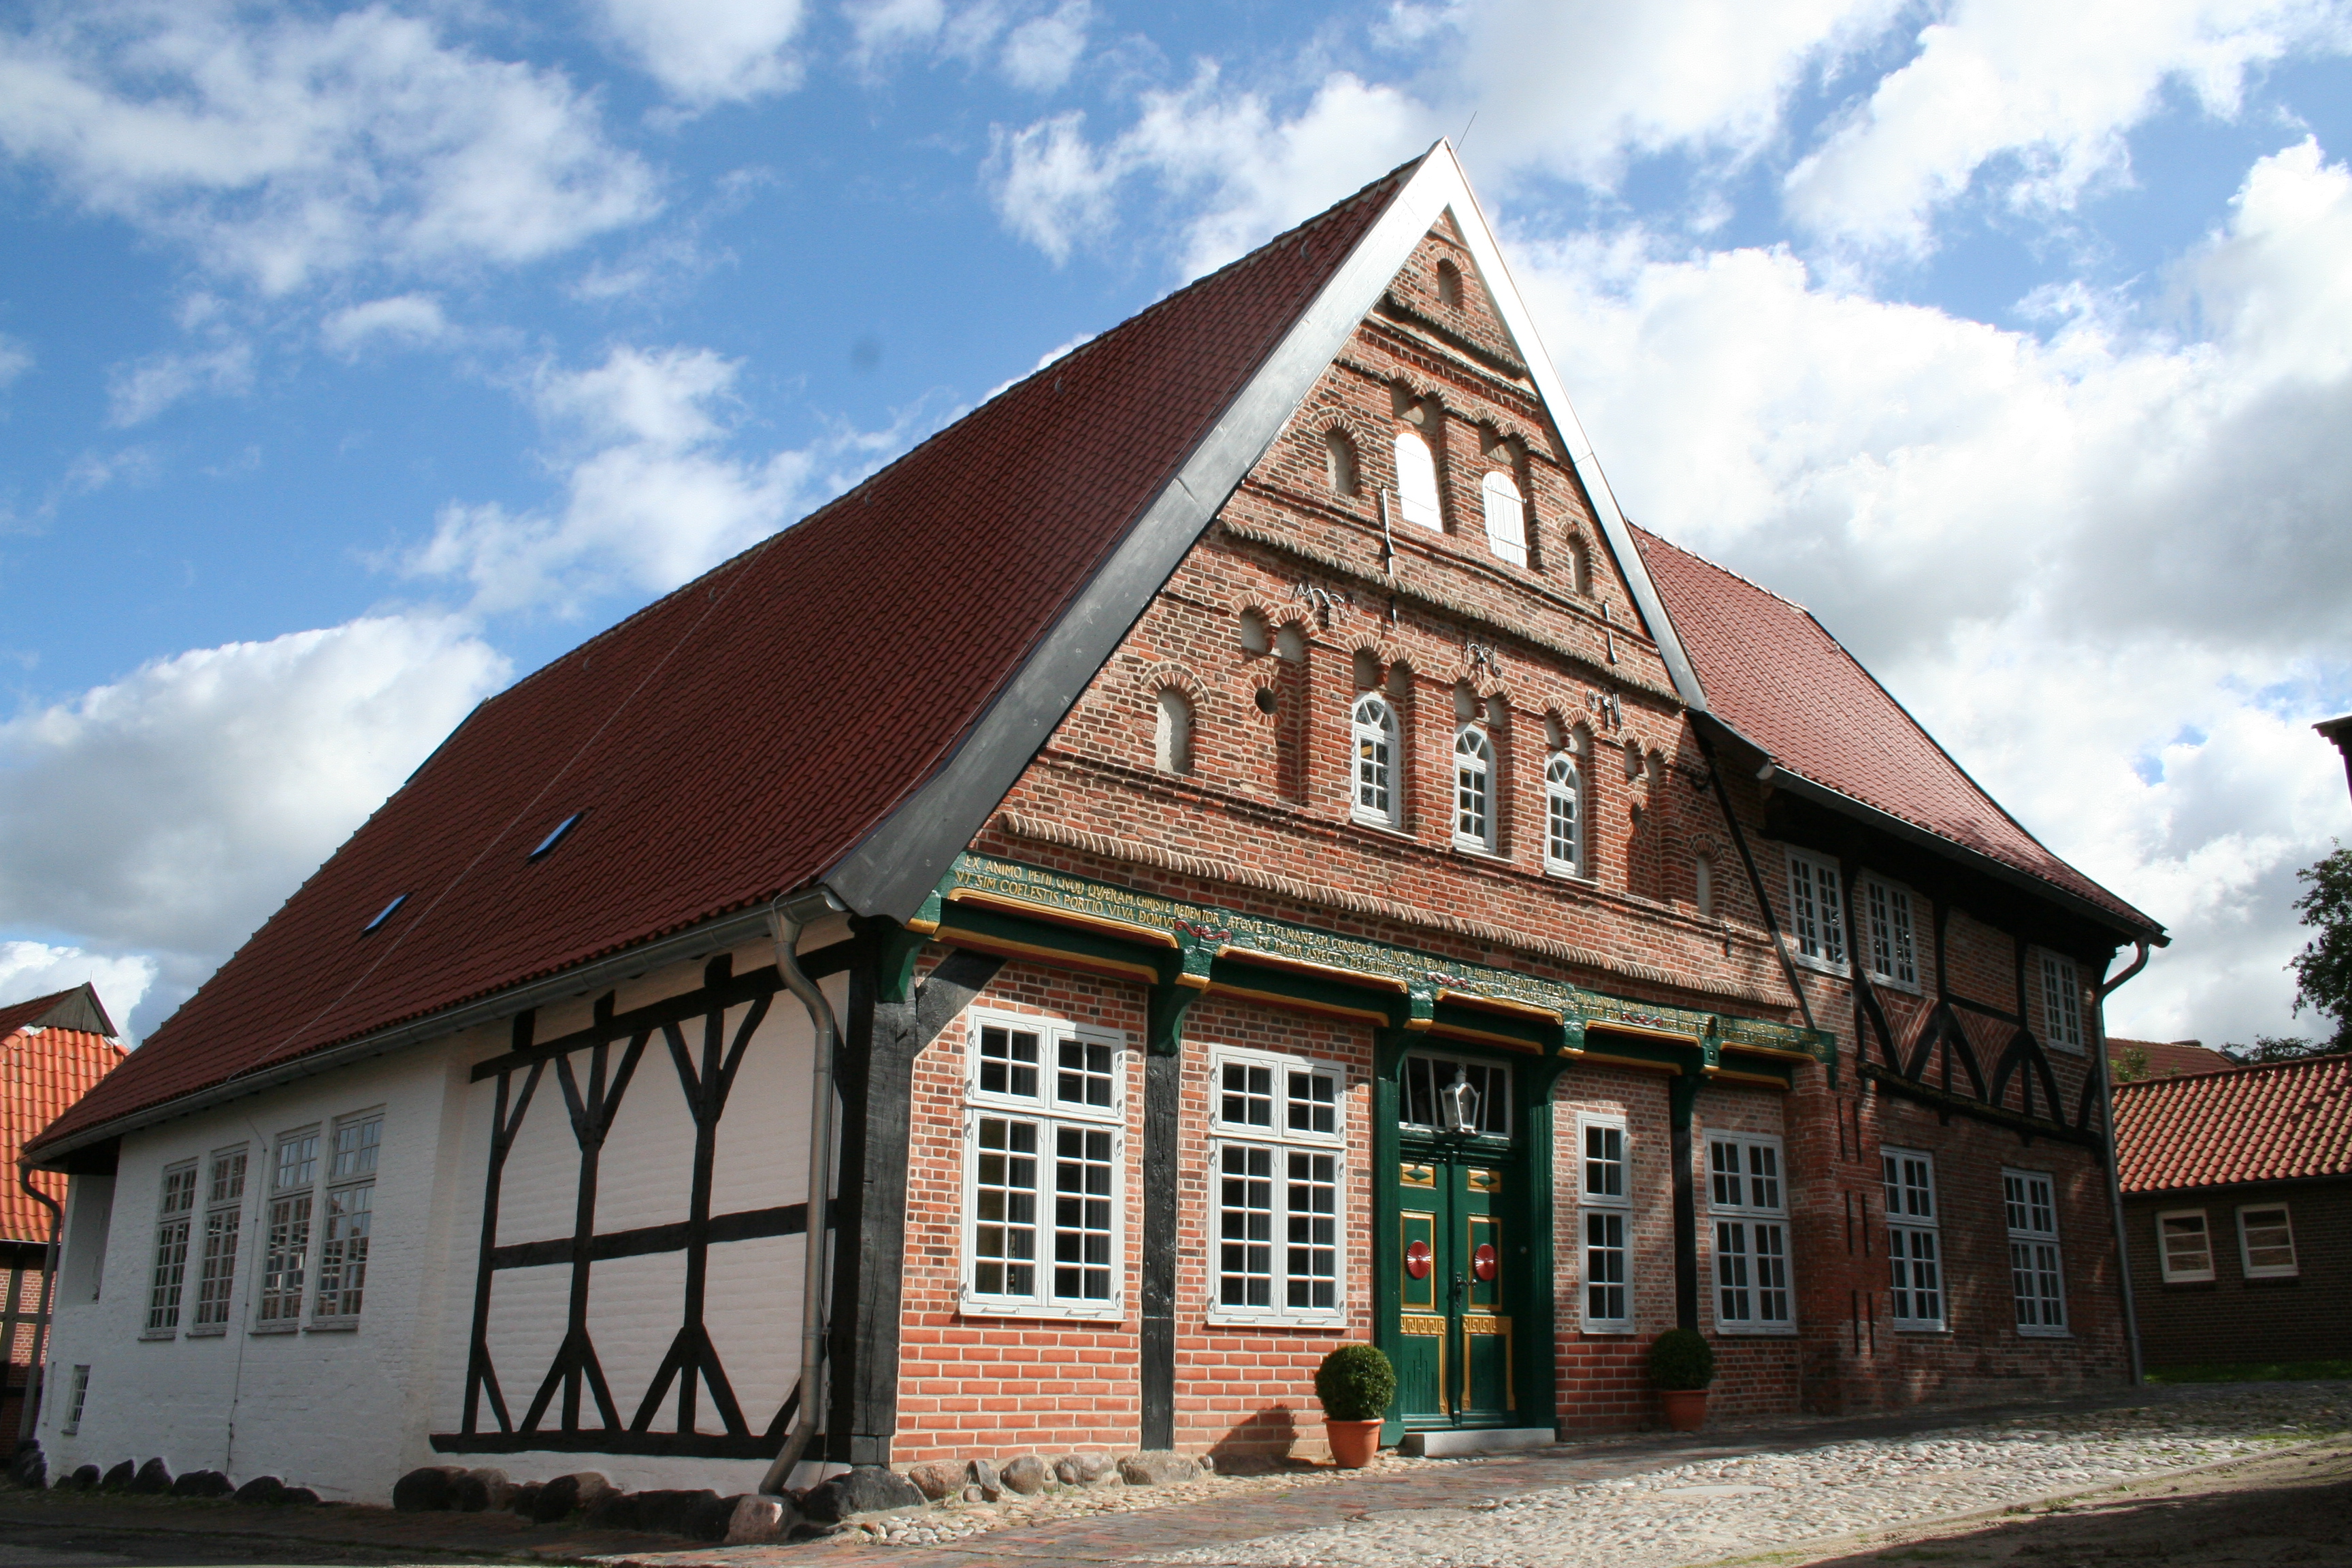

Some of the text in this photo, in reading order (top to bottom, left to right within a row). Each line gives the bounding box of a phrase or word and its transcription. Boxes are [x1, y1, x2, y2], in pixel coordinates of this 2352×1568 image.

[956, 869, 973, 885] VT
[974, 873, 996, 891] SIM
[1000, 878, 1059, 905] COELESTIS
[1064, 892, 1102, 915] PORTIO
[1138, 910, 1175, 930] DOMVS
[964, 854, 981, 870] EX
[984, 859, 1021, 879] ANIMO
[1137, 895, 1170, 915] CHRISTE
